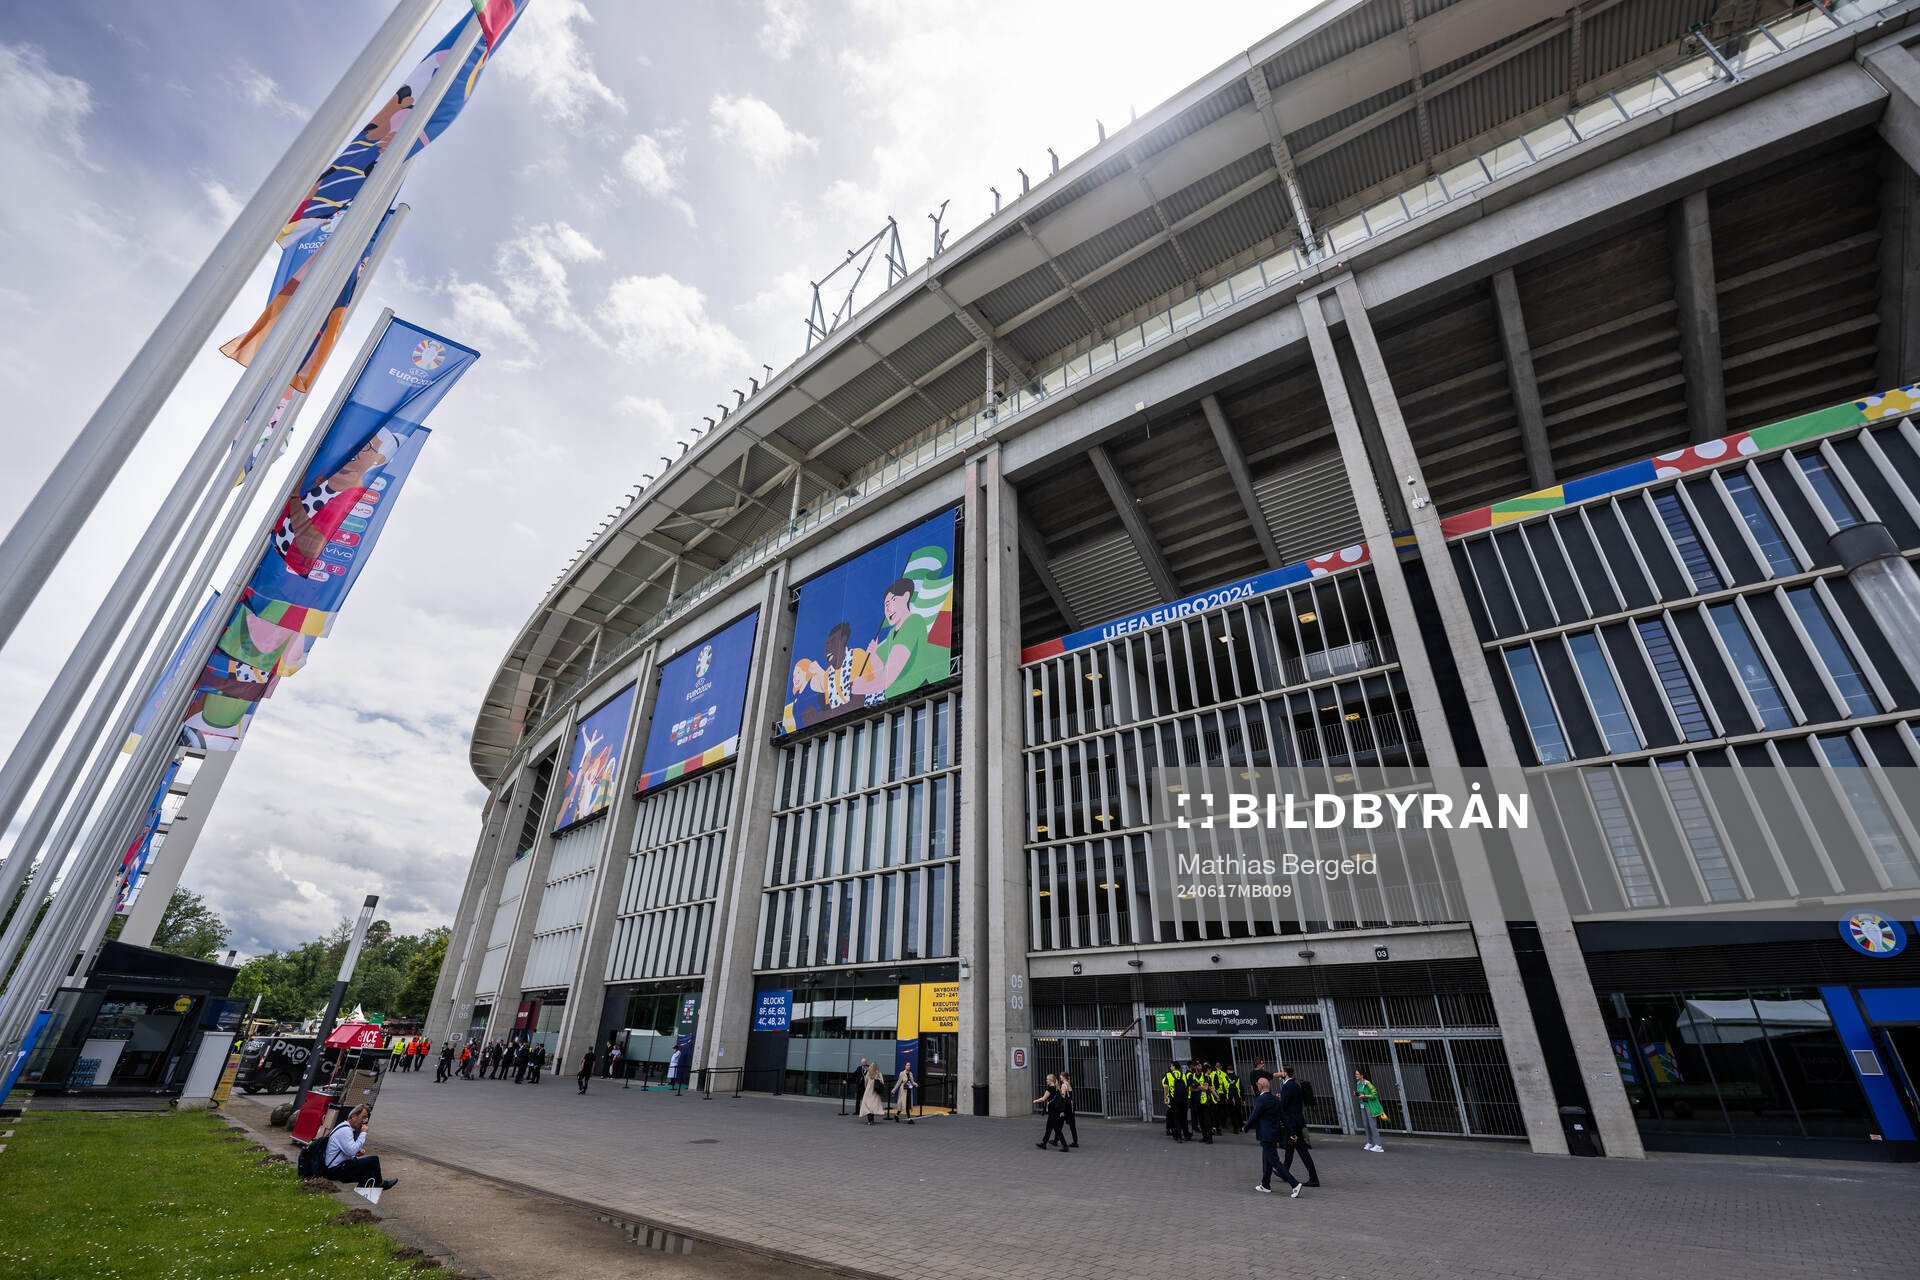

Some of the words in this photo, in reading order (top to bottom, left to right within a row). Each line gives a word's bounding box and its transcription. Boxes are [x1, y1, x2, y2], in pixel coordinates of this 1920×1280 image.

[325, 547, 352, 558] vivo
[1102, 616, 1150, 640] UEFA
[1011, 974, 1023, 988] 05
[763, 997, 784, 1005] BLOCKS
[1011, 995, 1024, 1009] 03
[1212, 1008, 1239, 1016] Eingang
[1224, 1017, 1258, 1026] Tiefgarage
[362, 1030, 379, 1043] ICE
